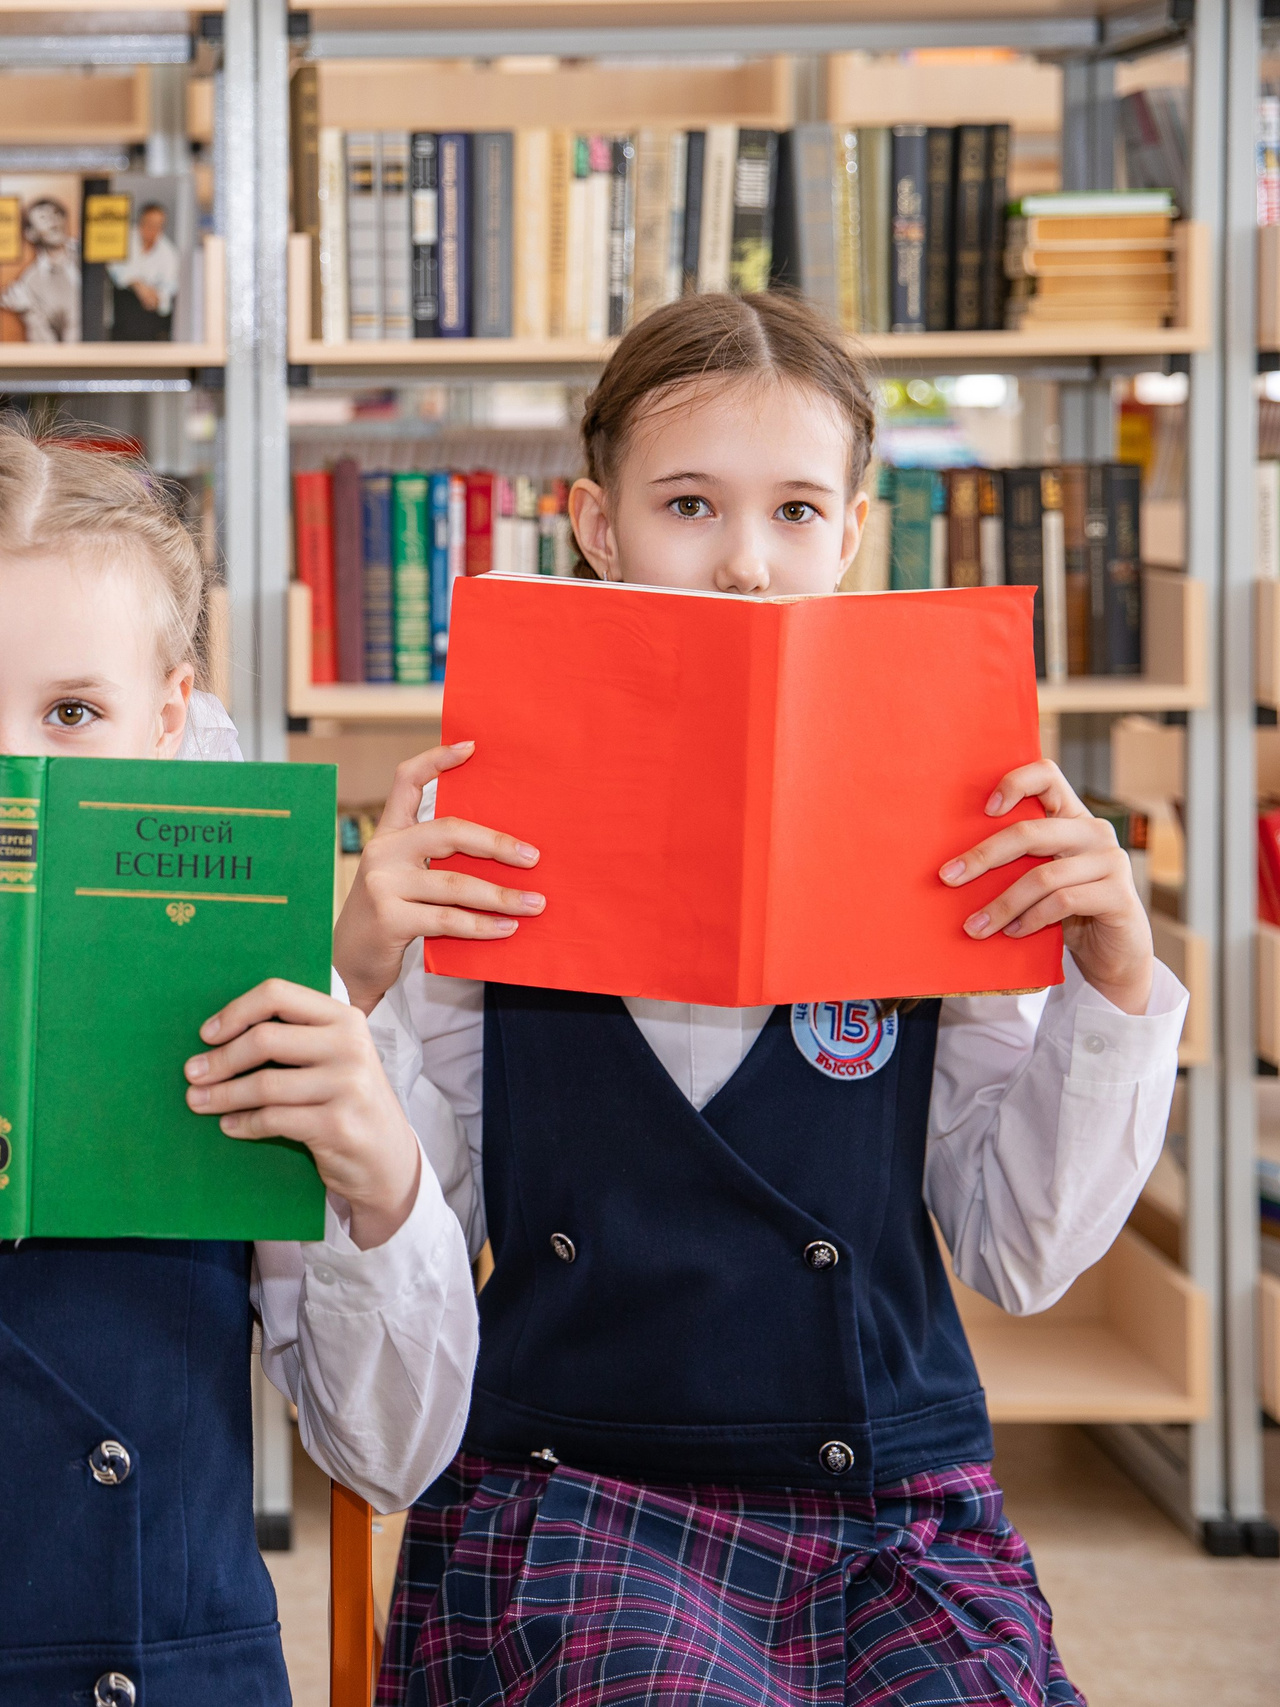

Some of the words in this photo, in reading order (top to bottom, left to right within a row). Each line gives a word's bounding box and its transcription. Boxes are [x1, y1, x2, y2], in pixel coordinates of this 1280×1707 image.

[135, 816, 233, 848] Сергей
[115, 851, 253, 880] ЕСЕНИН
[824, 1001, 870, 1044] 15
[815, 1051, 875, 1076] ВЫСОТА
